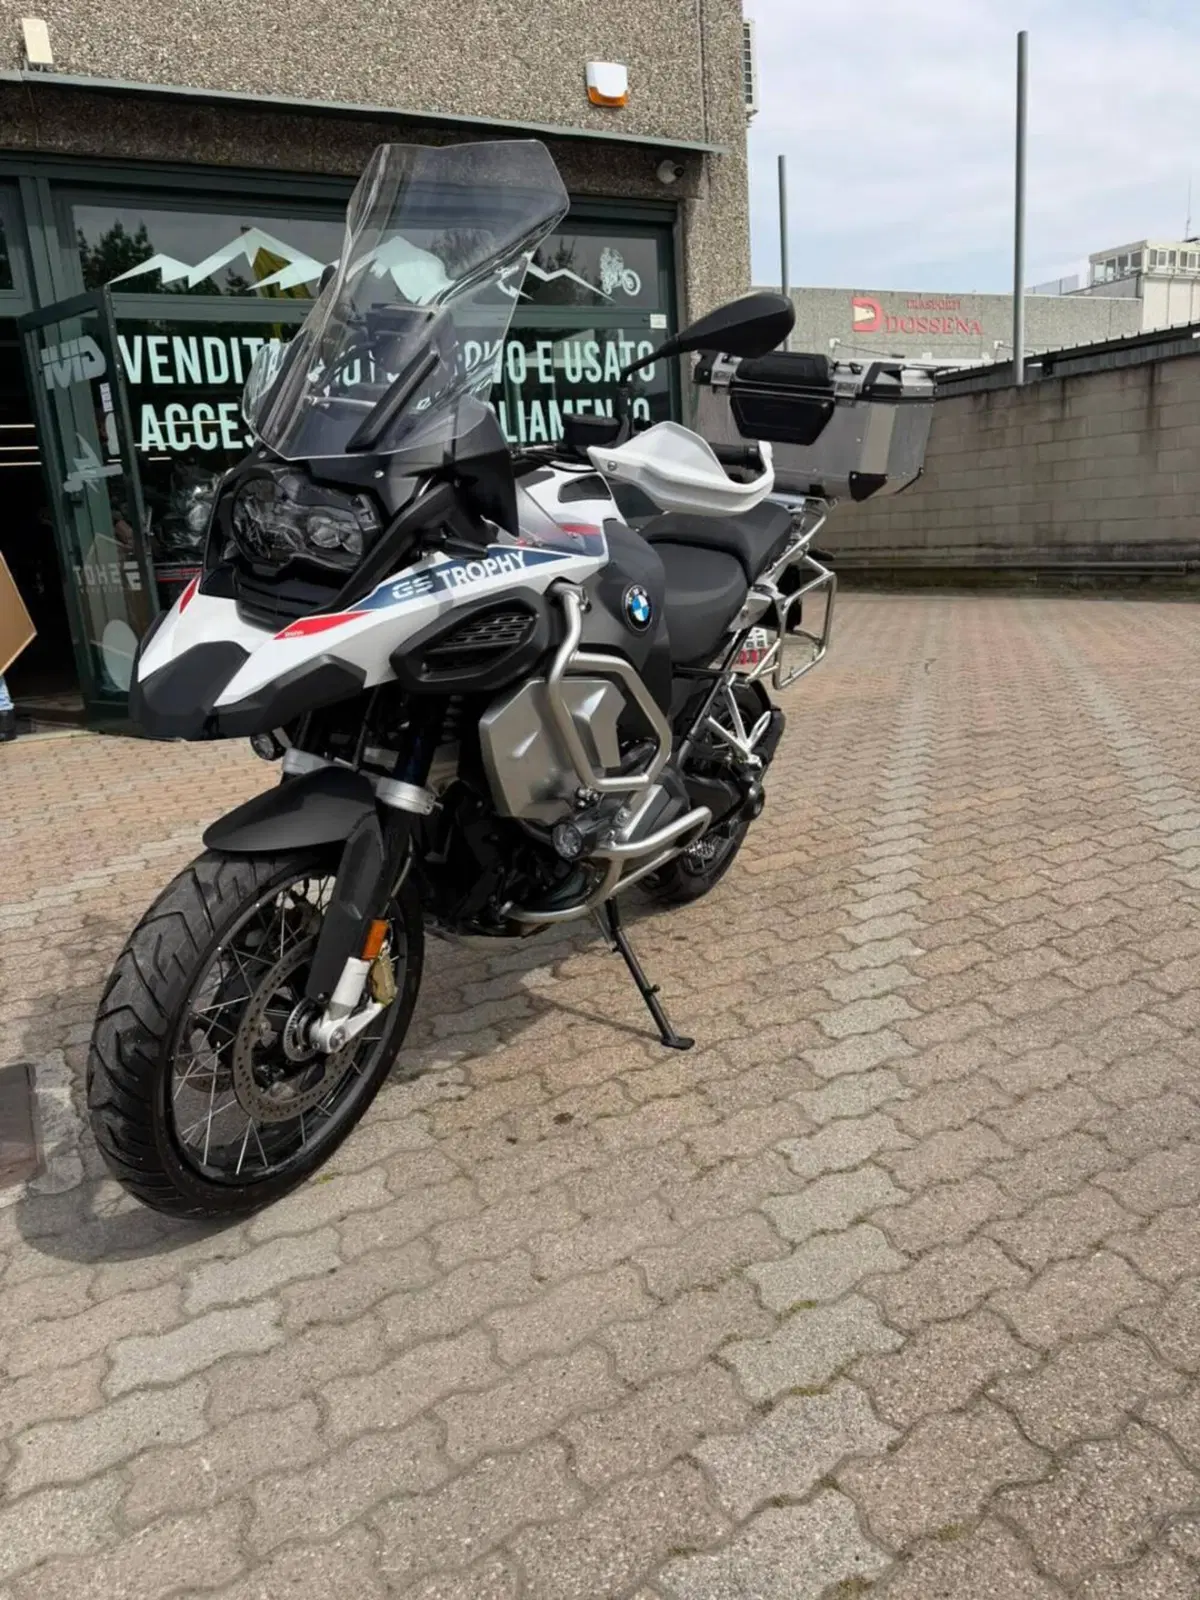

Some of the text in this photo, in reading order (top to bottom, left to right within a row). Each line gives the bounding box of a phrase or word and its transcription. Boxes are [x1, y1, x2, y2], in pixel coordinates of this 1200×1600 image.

[885, 315, 984, 336] DOSSENA
[536, 341, 555, 384] E
[564, 340, 655, 384] USATO
[391, 551, 526, 599] GS TROPHY
